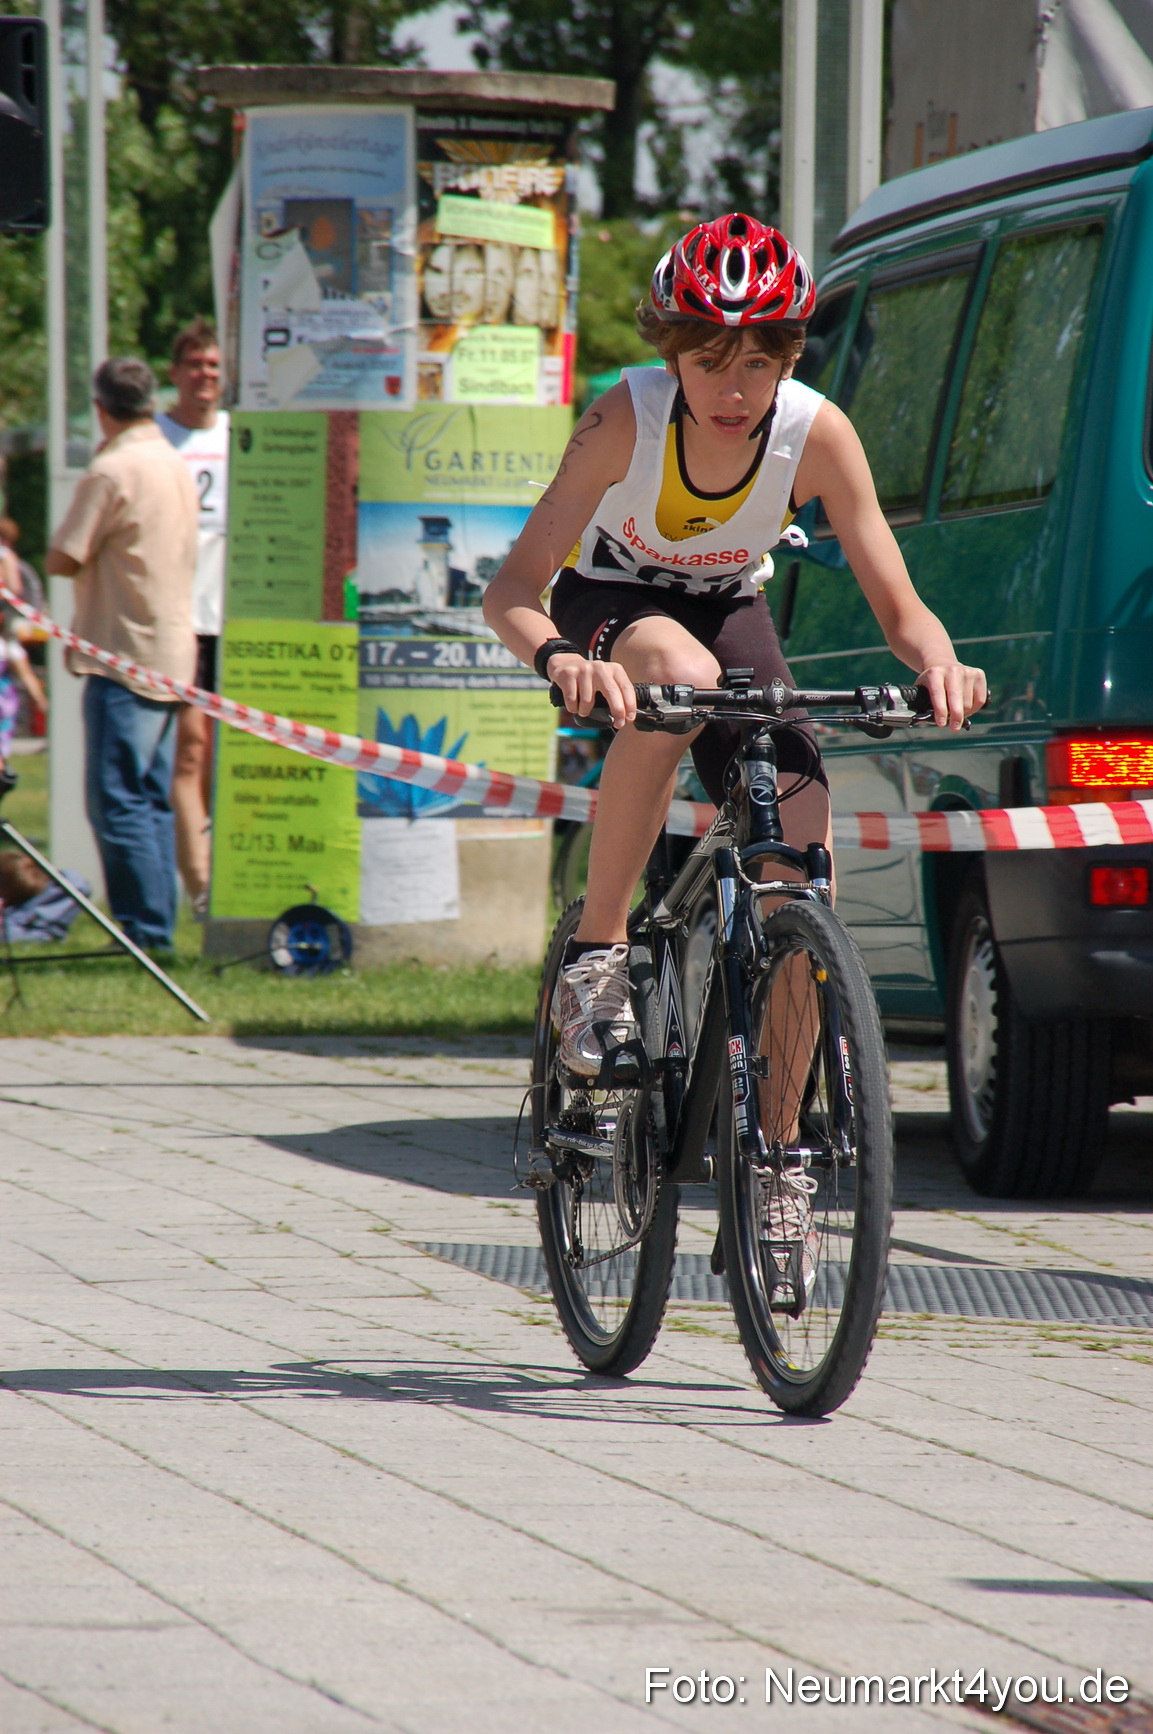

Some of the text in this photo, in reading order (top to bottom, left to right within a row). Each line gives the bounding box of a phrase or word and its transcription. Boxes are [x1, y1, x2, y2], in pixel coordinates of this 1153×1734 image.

[622, 517, 749, 566] Sparkasse
[365, 642, 404, 666] 17.
[433, 642, 472, 667] 20.
